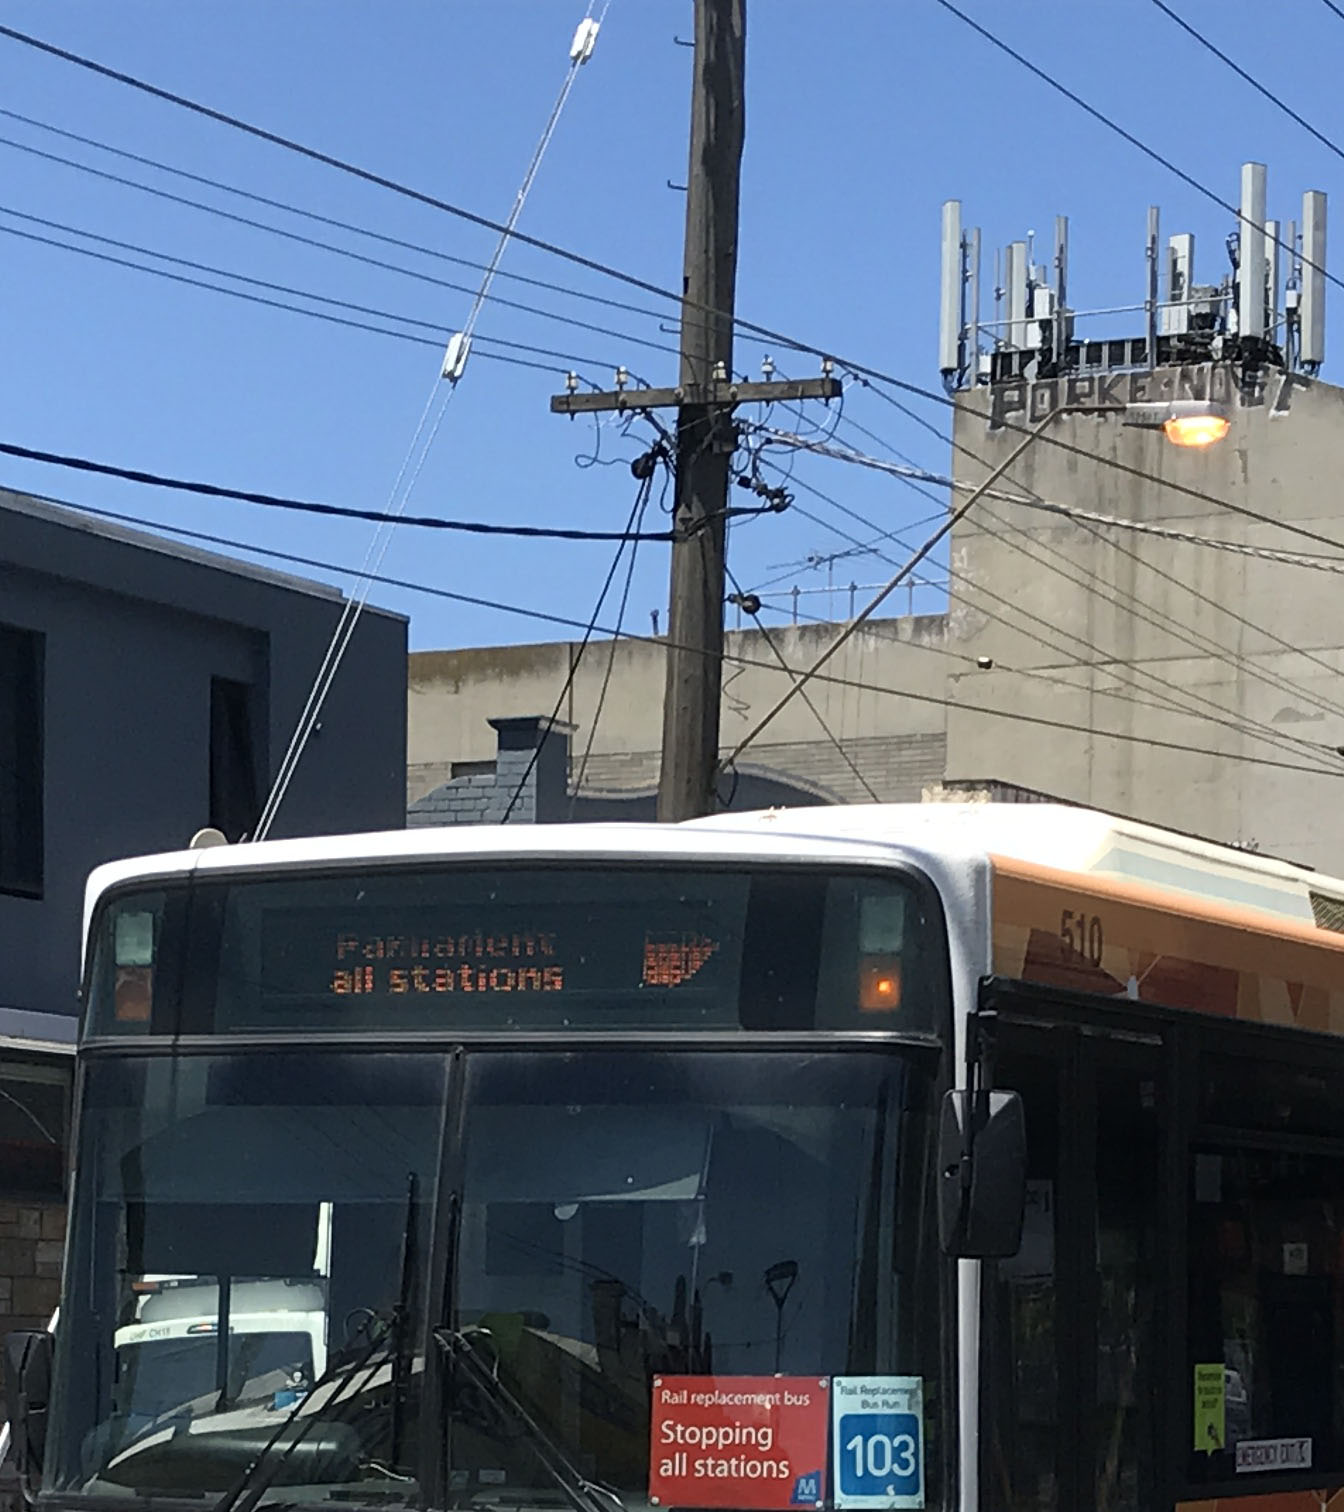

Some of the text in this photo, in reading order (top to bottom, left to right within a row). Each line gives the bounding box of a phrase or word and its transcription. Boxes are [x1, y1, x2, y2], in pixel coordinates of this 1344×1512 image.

[331, 965, 563, 994] all stations
[660, 1389, 810, 1408] Rail replacement bus
[860, 1400, 880, 1410] Bus
[660, 1419, 773, 1451] Stopping
[659, 1451, 790, 1479] all stations
[845, 1433, 916, 1478] 103
